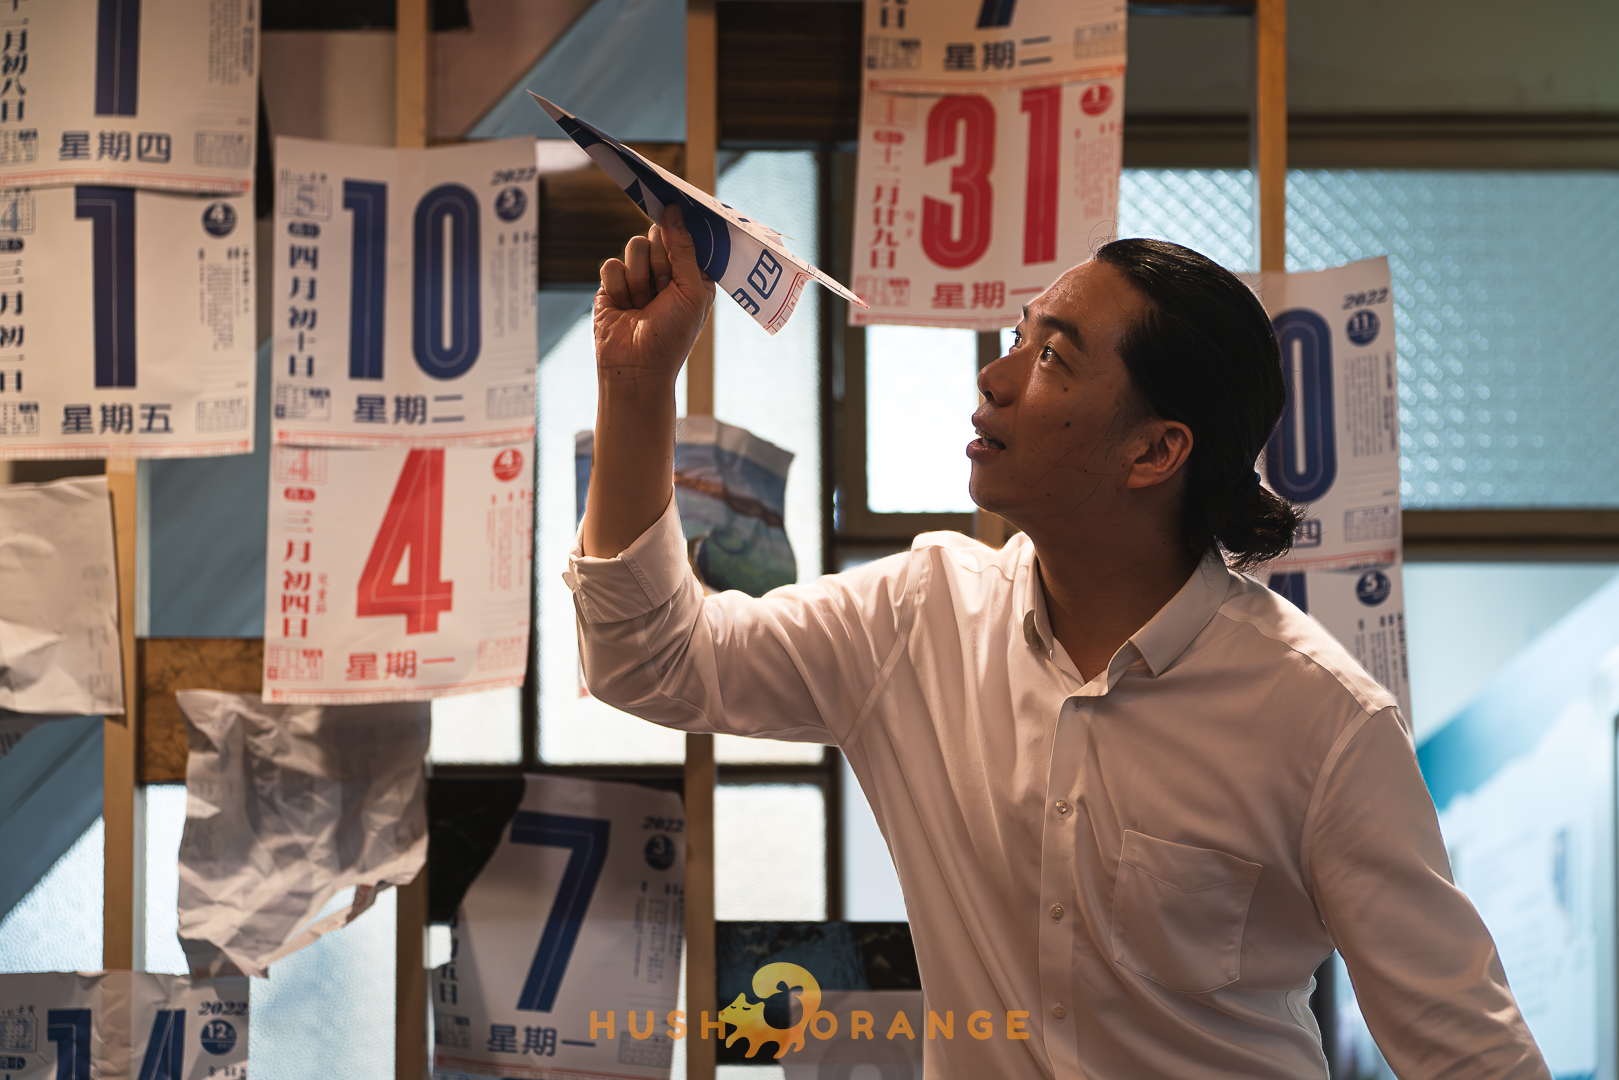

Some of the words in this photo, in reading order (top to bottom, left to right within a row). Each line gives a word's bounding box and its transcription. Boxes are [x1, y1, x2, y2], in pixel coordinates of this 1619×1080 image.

[943, 36, 1052, 71] 星期二
[58, 130, 171, 163] 星期四
[489, 166, 537, 187] 2022
[920, 85, 1063, 270] 31
[75, 184, 138, 390] 1
[342, 177, 481, 381] 10
[932, 281, 1044, 310] 星期一
[287, 243, 320, 379] 四月初十日
[1342, 286, 1389, 310] 2022
[61, 403, 173, 434] 星期五
[354, 392, 465, 425] 星期二
[356, 448, 454, 635] 4
[282, 508, 314, 639] 三月初四日
[346, 650, 455, 682] 星期一
[642, 815, 685, 833] 2022
[509, 810, 611, 1014] 7
[198, 1001, 248, 1016] 2022
[488, 1024, 596, 1057] 星期一
